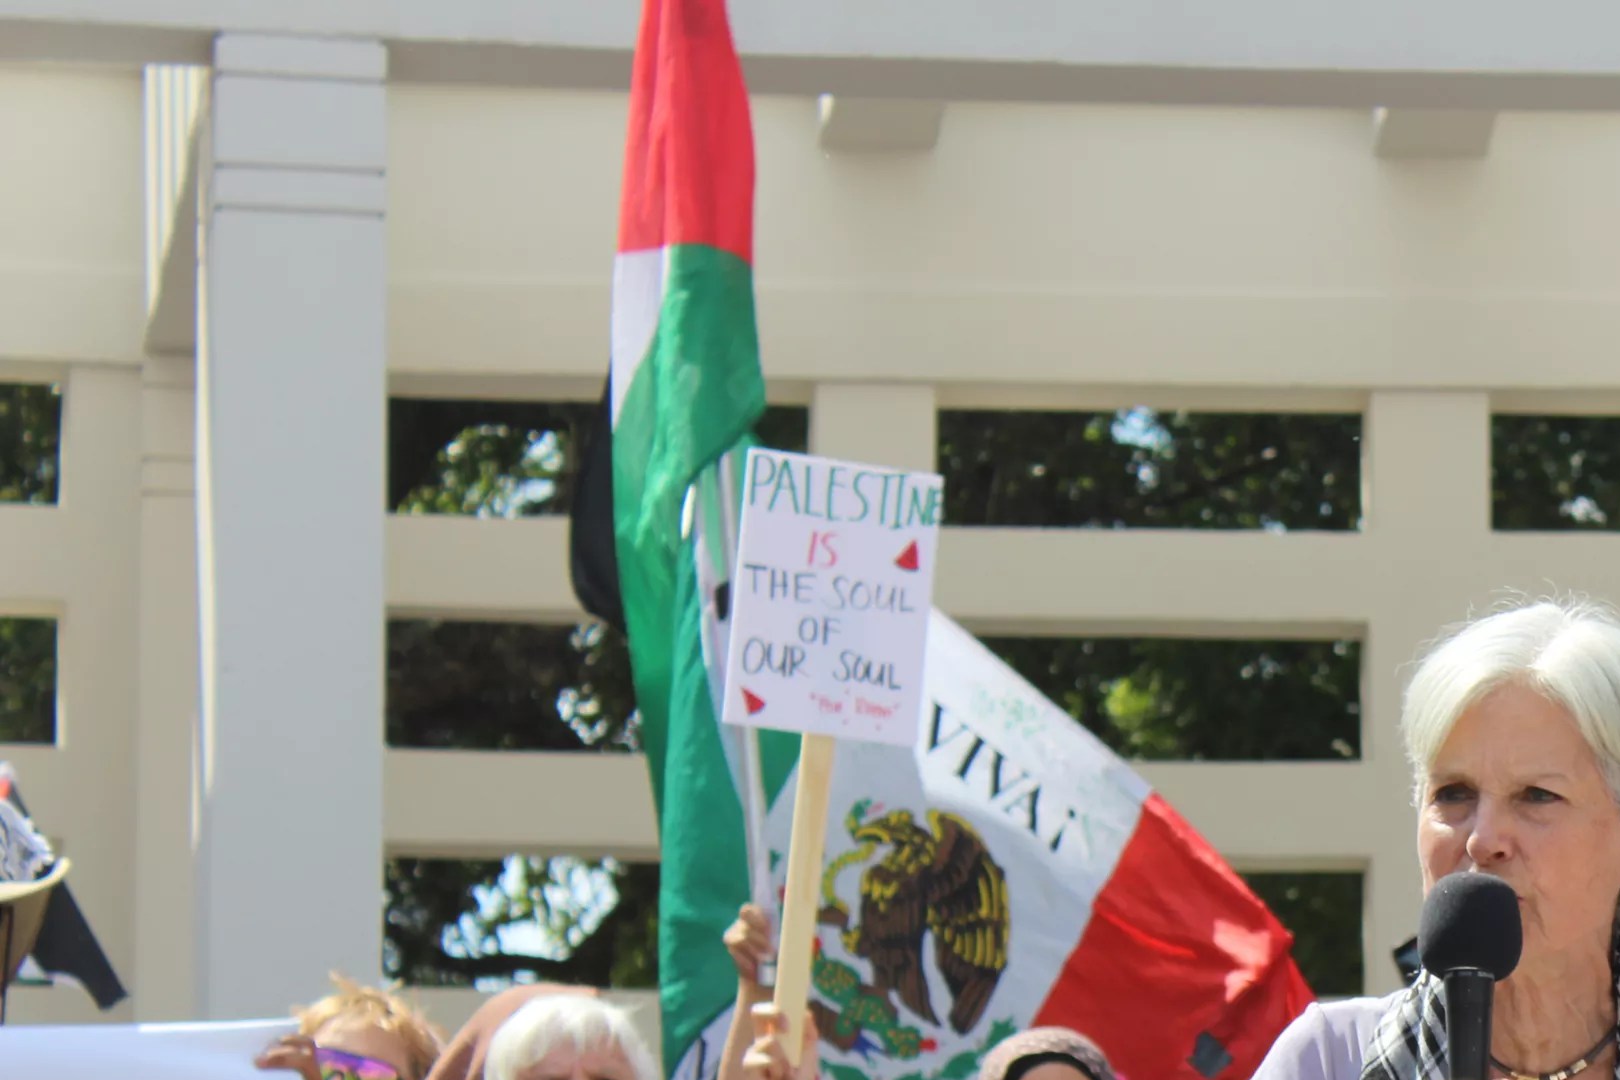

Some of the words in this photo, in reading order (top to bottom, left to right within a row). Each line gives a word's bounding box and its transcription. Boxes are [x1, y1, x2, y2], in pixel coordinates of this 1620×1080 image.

[749, 453, 944, 531] PALESTINE
[807, 530, 838, 568] IS
[744, 562, 817, 604] THE
[830, 575, 916, 613] SOUL
[798, 616, 842, 646] OF
[741, 636, 812, 679] OUR
[831, 648, 903, 690] SOUL
